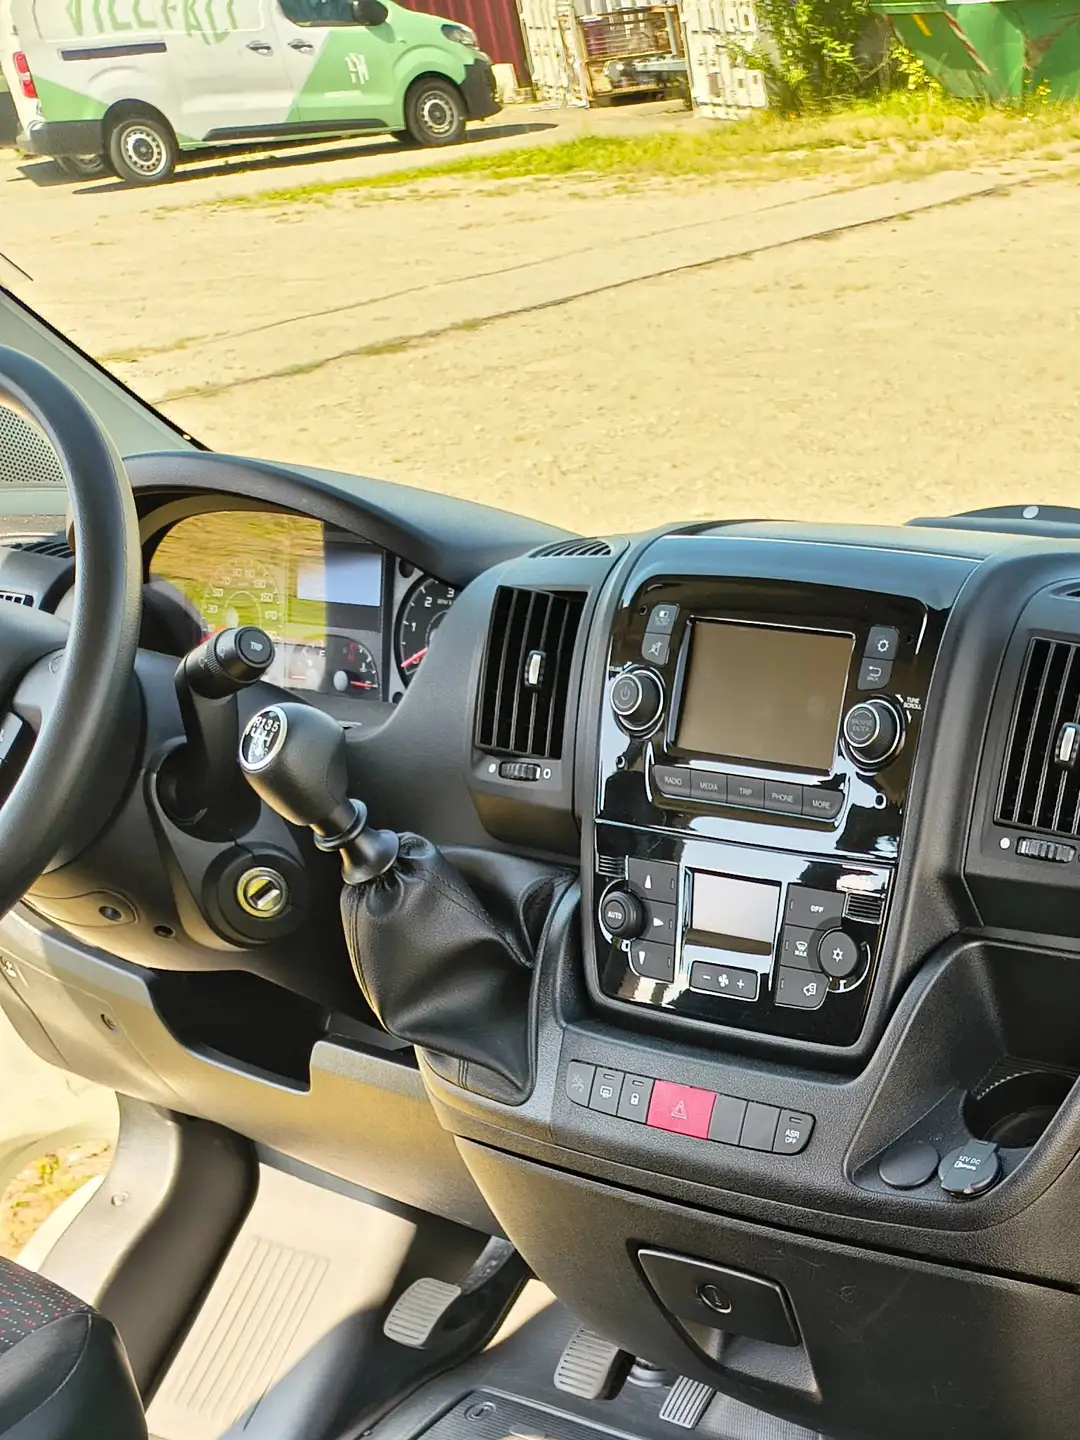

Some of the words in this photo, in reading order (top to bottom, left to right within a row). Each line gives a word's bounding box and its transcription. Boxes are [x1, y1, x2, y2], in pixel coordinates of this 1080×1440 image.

[447, 588, 455, 598] 3
[424, 597, 432, 607] 2
[411, 622, 417, 631] 1
[664, 776, 682, 786] RADIO
[700, 782, 718, 791] MEDIA
[739, 787, 753, 796] TRIP
[771, 792, 794, 803] PHONE
[812, 800, 831, 810] MORE
[810, 905, 824, 913] OFF
[607, 911, 622, 920] AUTO
[785, 1128, 800, 1139] ASR
